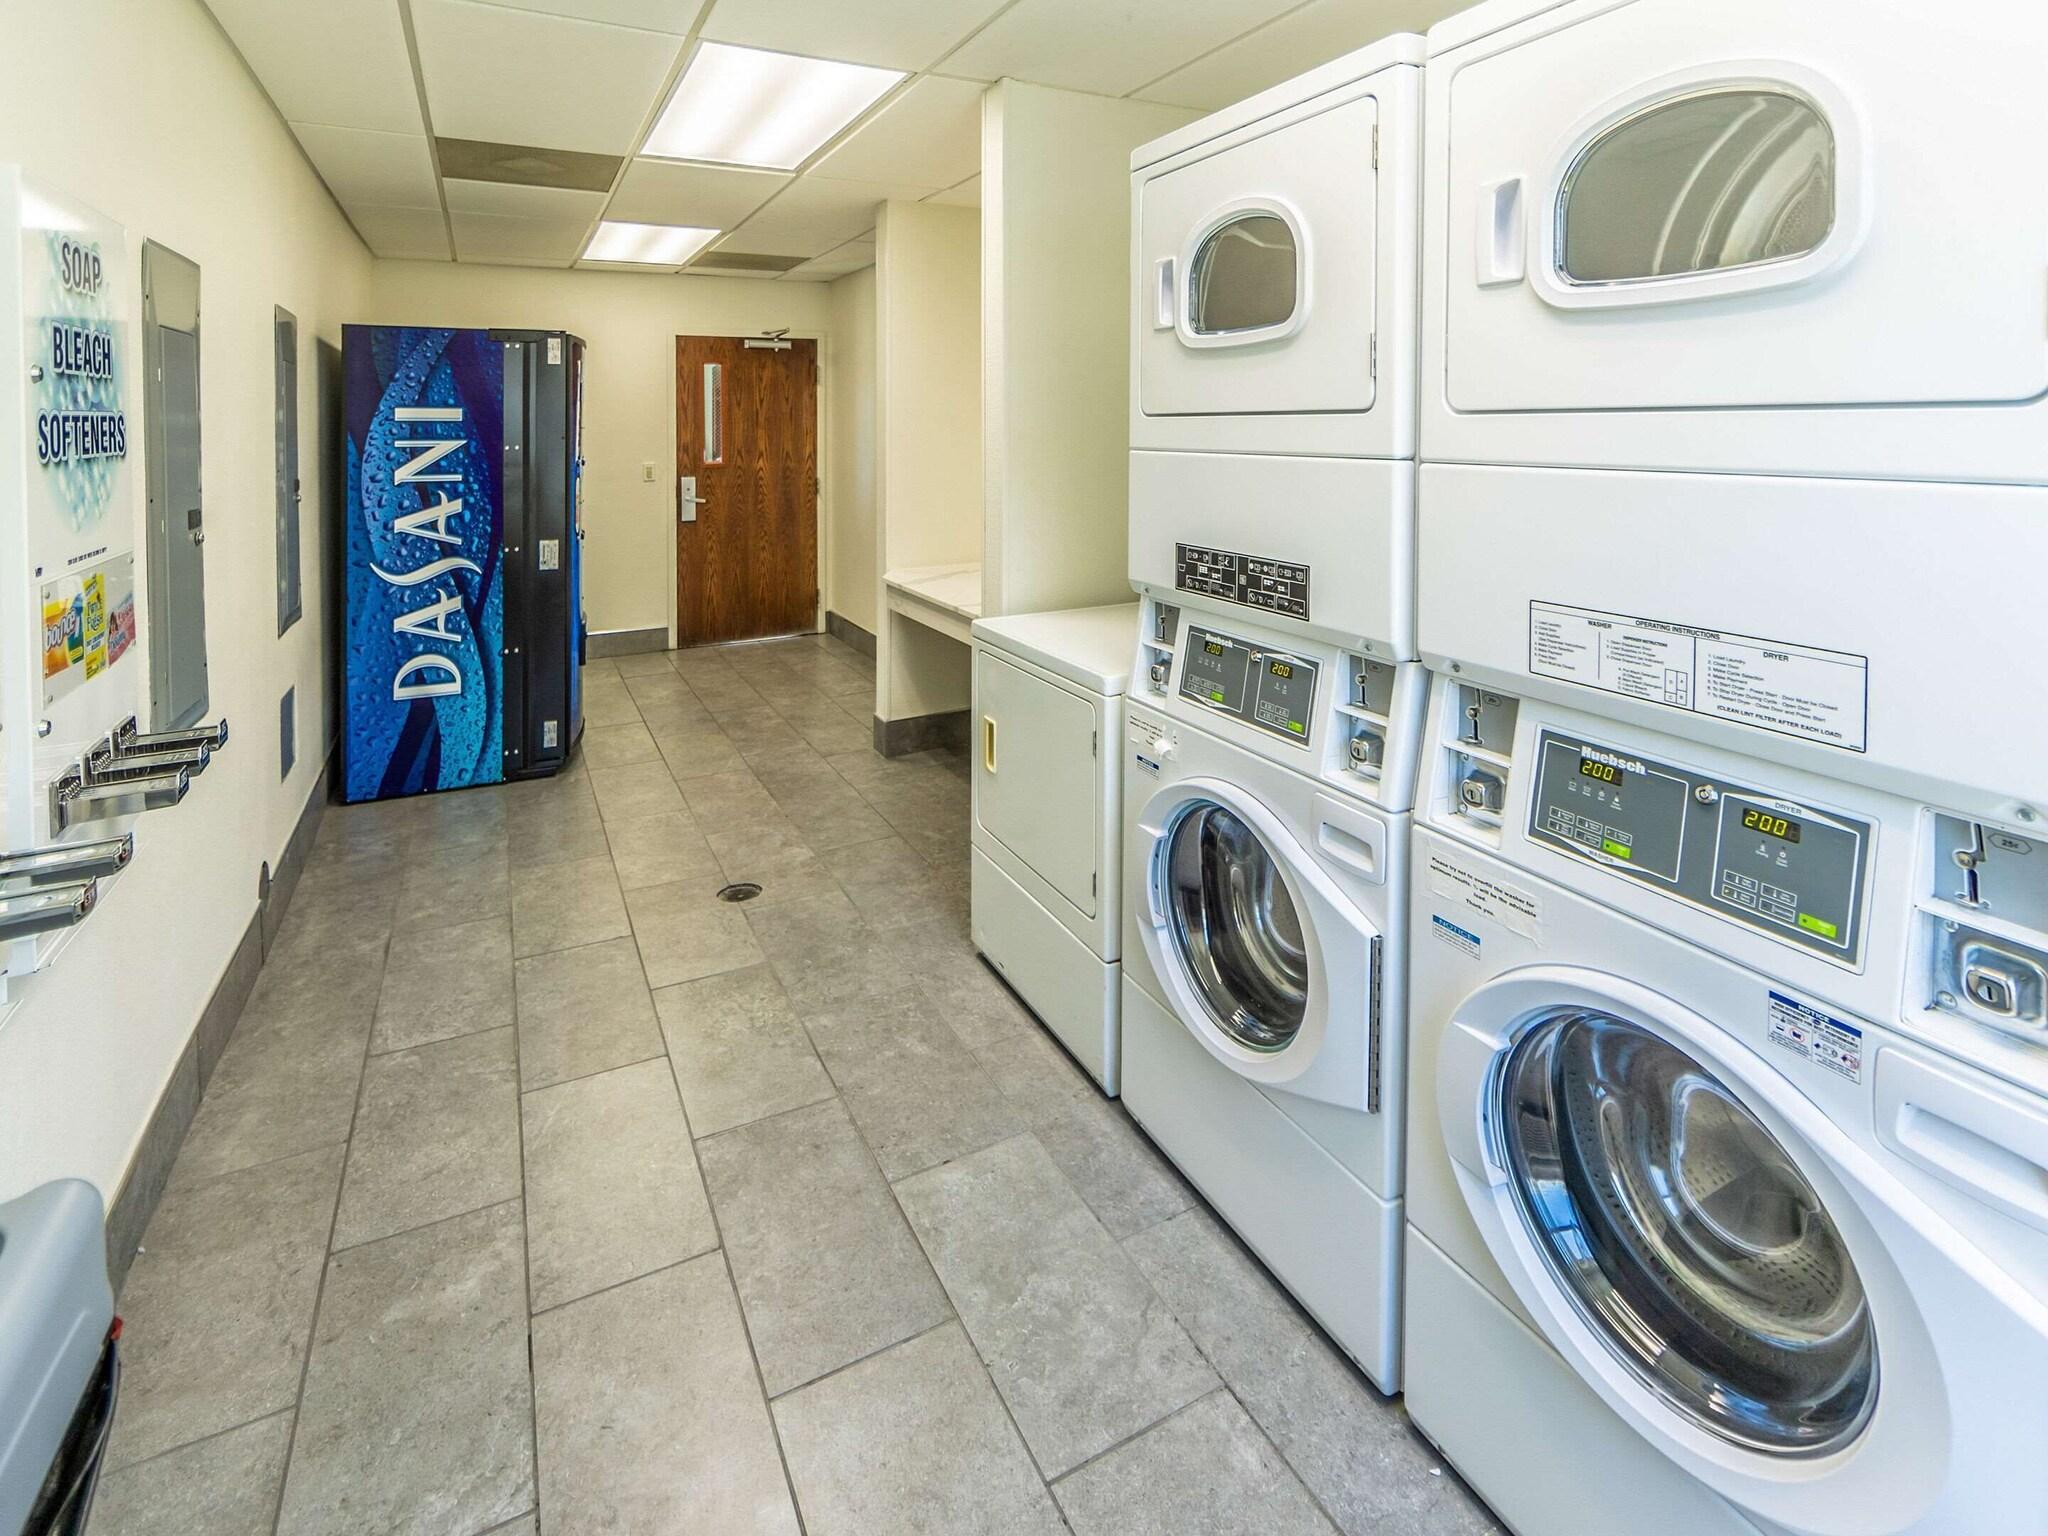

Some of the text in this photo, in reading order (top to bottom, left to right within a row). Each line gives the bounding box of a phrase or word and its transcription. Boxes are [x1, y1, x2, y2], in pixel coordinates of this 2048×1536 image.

[61, 240, 101, 294] SOAP
[53, 325, 112, 376] BLEACH
[38, 412, 126, 462] SOFTENERS
[370, 407, 482, 700] DASANI
[1588, 620, 1612, 629] WASHER
[1635, 620, 1720, 640] OPERATING INSTRUCTIONS
[1206, 642, 1221, 656] 200
[1763, 652, 1789, 662] DRYER
[1272, 663, 1290, 678] 200
[1581, 745, 1648, 776] Huebsch
[1582, 760, 1615, 781] 200
[1745, 811, 1788, 837] 200
[1798, 1004, 1830, 1024] NOTICE
